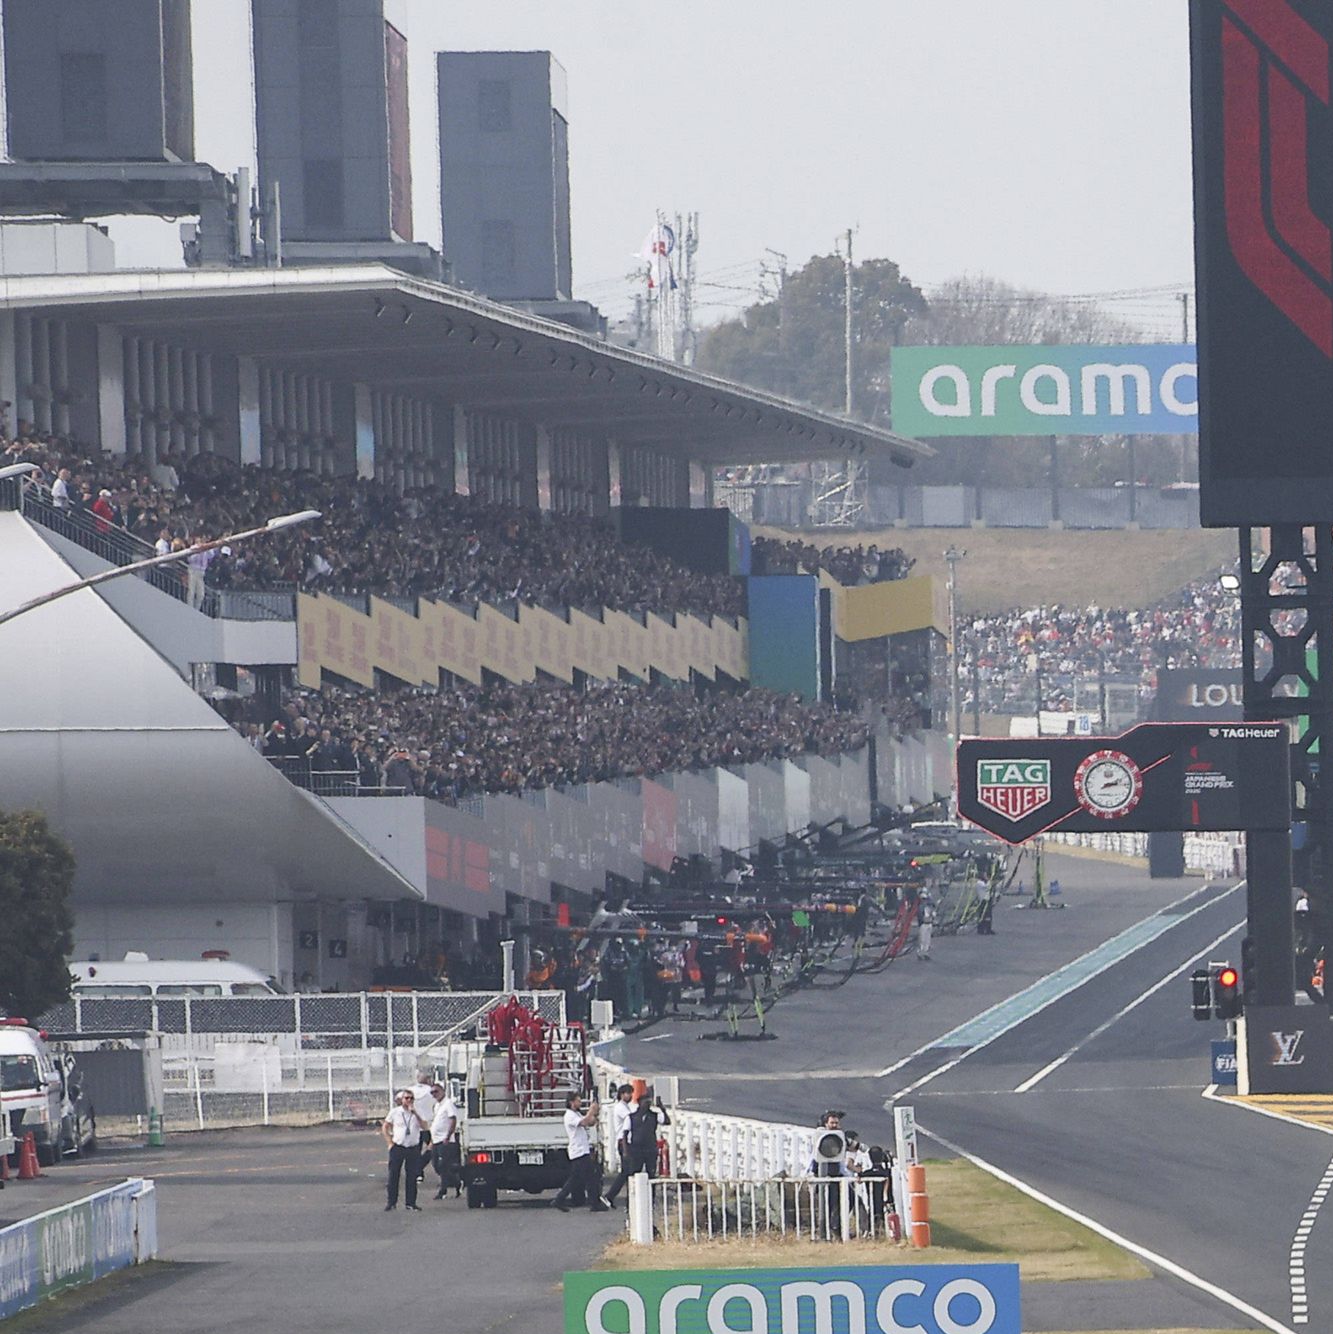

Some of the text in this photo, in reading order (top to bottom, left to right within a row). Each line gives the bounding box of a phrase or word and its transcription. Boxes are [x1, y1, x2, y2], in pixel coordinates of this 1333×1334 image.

[918, 362, 1197, 417] aramc
[1192, 684, 1243, 706] LOU
[983, 764, 1043, 783] TAG
[982, 786, 1047, 815] HEUER
